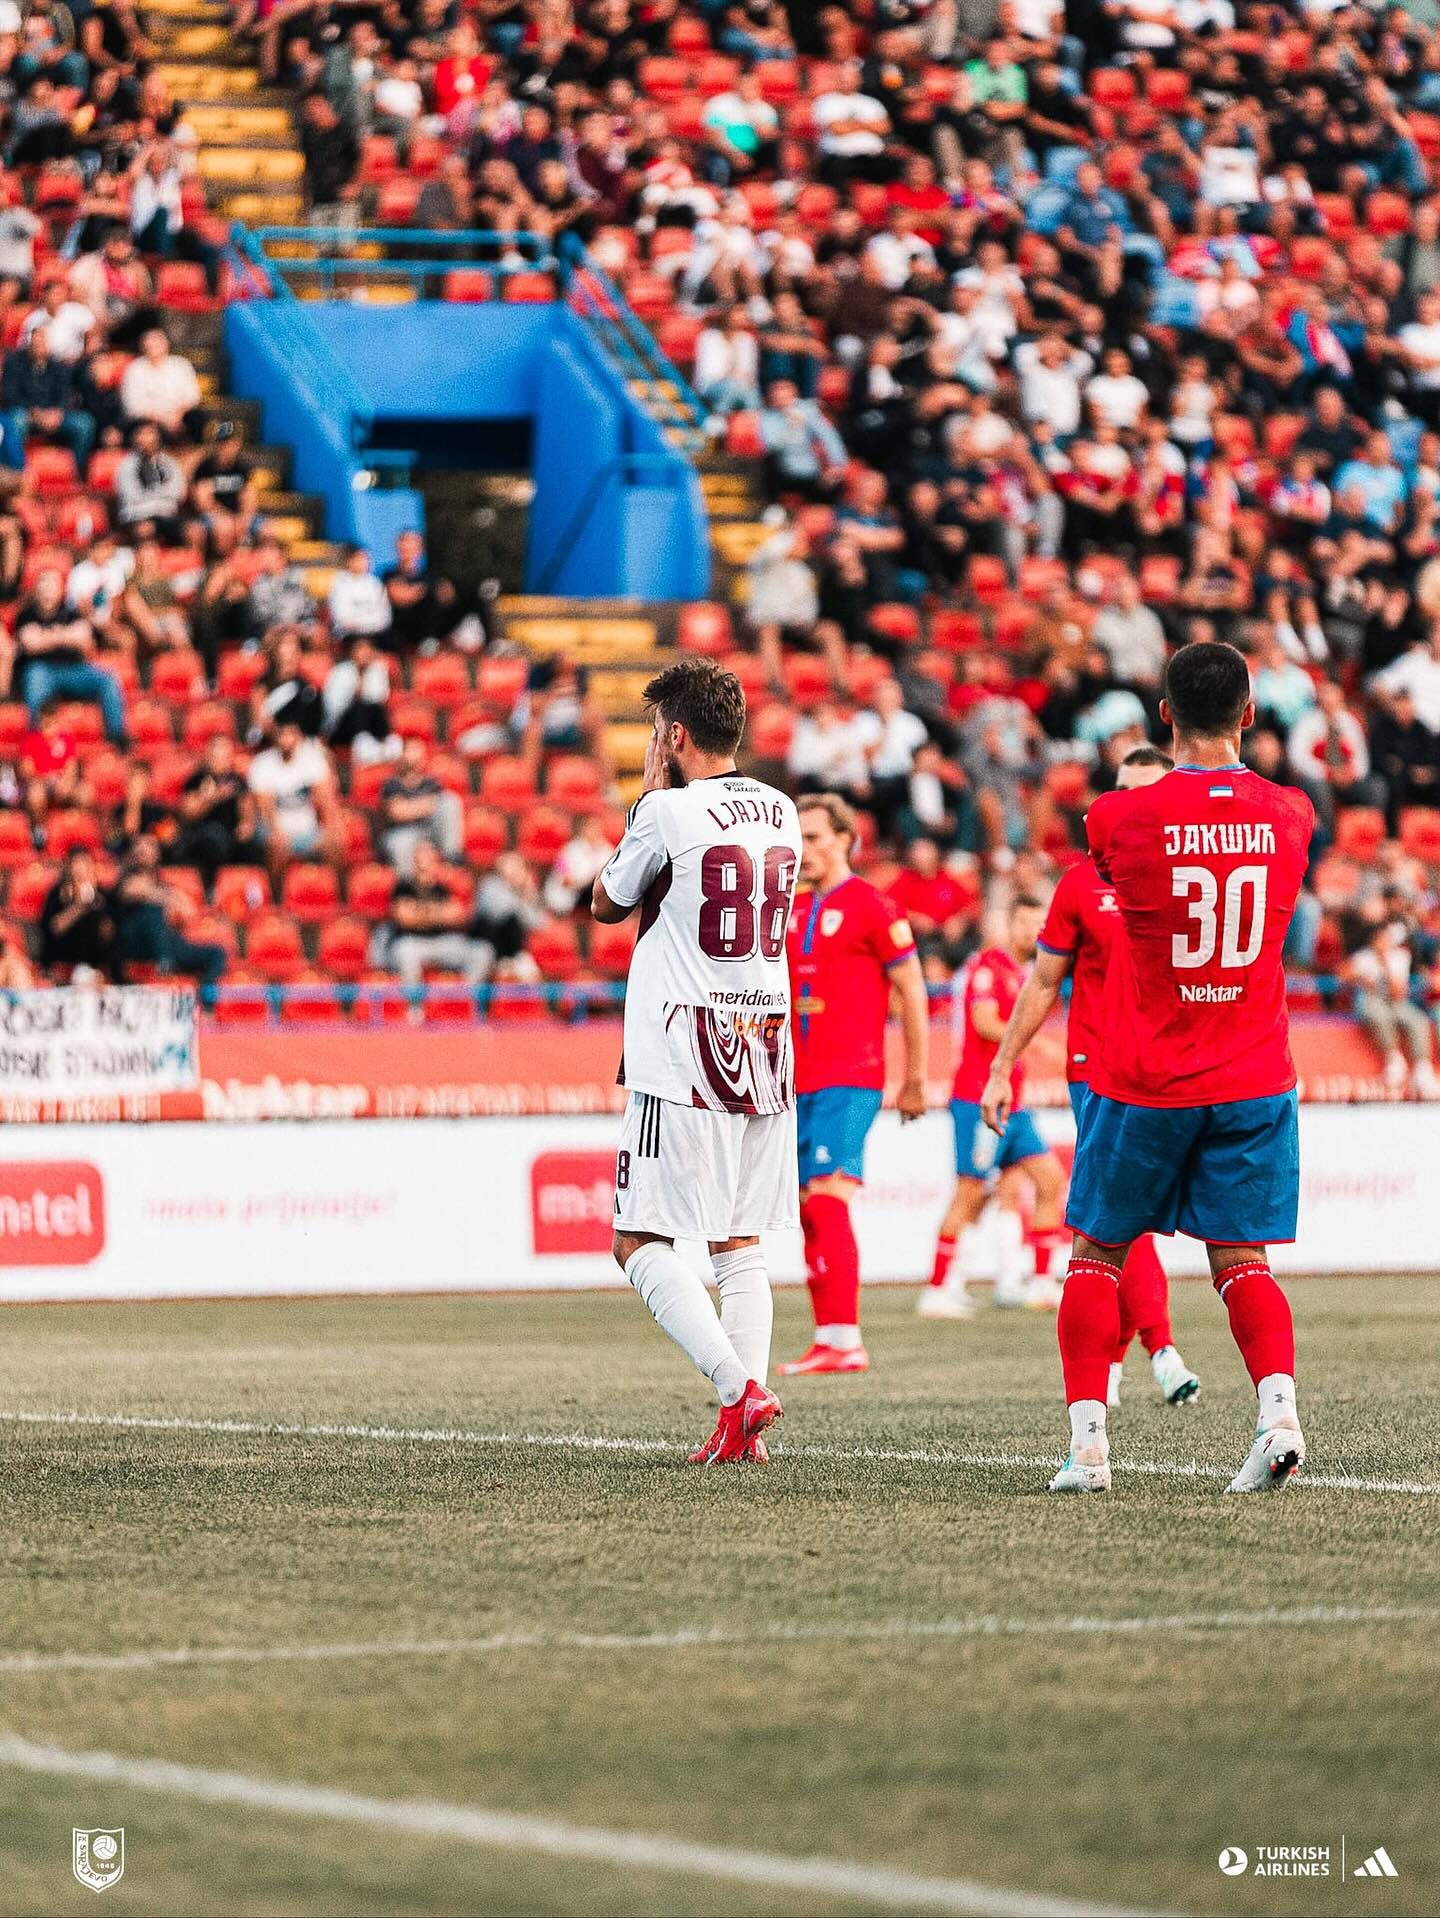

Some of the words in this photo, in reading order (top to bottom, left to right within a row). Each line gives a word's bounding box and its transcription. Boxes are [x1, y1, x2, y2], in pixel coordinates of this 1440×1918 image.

[1164, 823, 1276, 856] ЈАКШИЋ
[698, 845, 797, 962] 88
[1171, 865, 1268, 969] 30
[1179, 983, 1243, 1003] Nektar
[617, 1150, 631, 1190] 8
